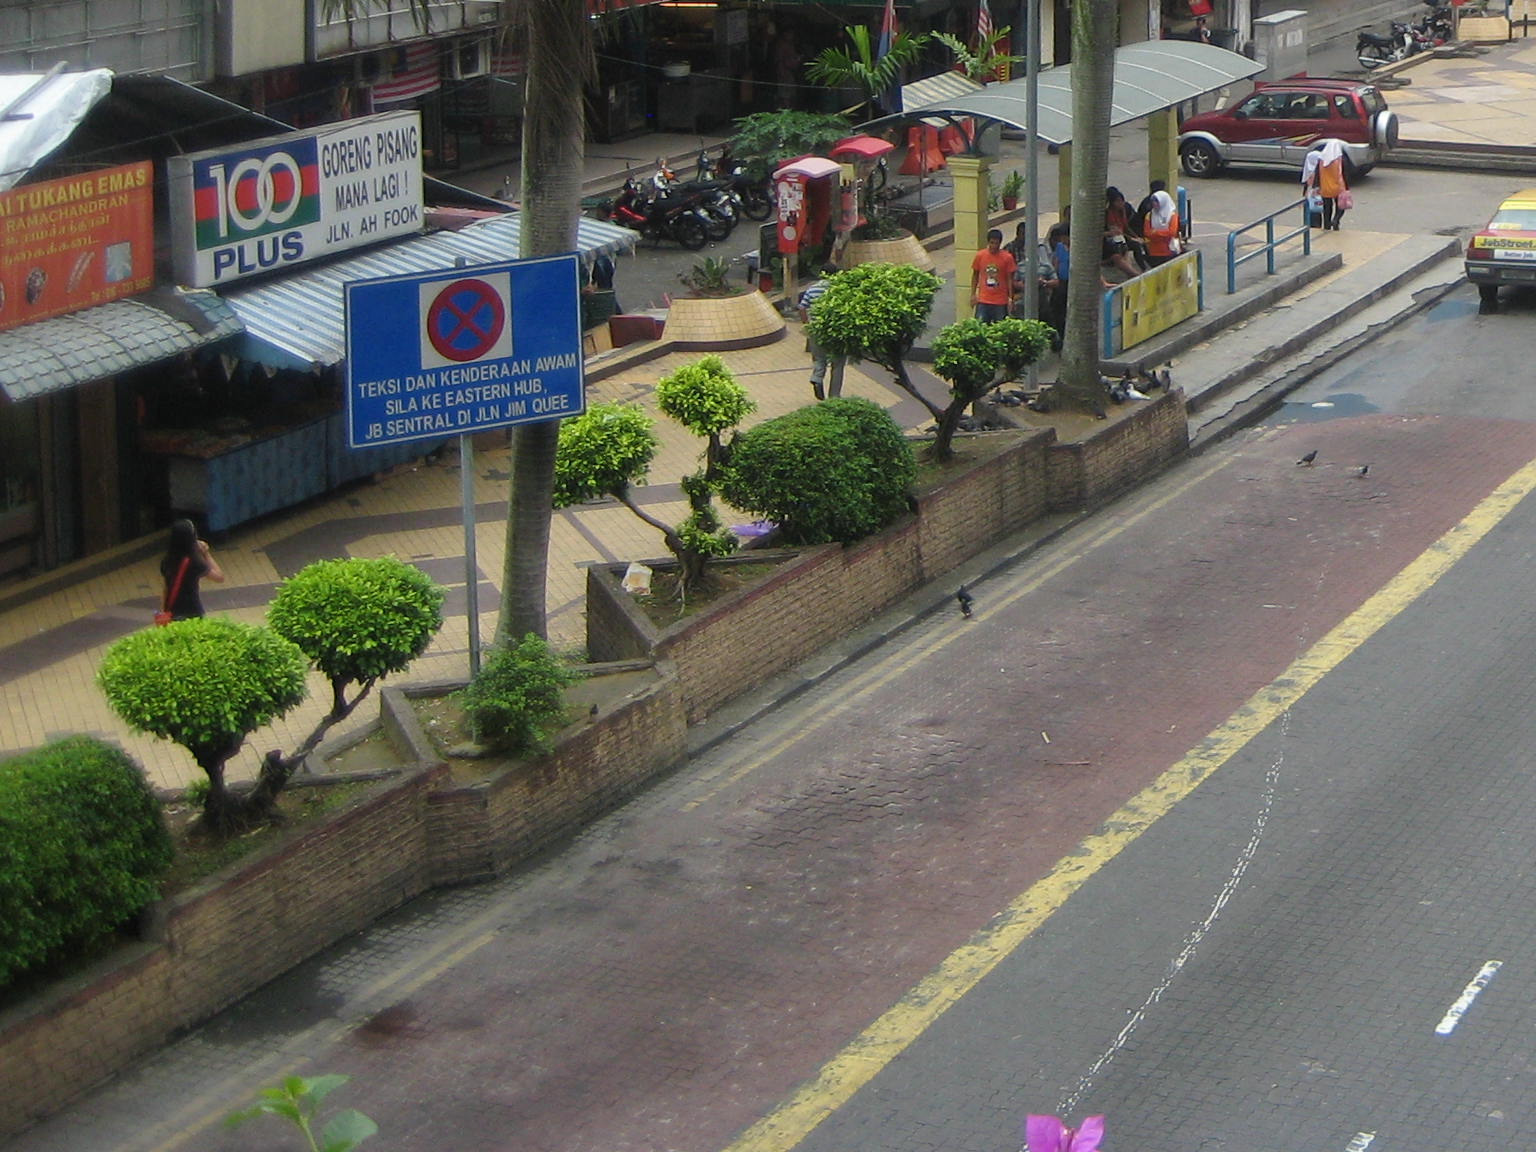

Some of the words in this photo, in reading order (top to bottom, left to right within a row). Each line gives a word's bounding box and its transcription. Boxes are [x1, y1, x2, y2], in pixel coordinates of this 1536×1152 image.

[322, 136, 371, 179] GORENG
[377, 126, 418, 167] PISANG
[16, 179, 93, 212] TUKANG
[97, 168, 146, 195] EMAS
[209, 152, 302, 238] 100
[335, 180, 369, 212] MANA
[374, 175, 399, 202] LAGI
[404, 171, 408, 195] !
[7, 194, 129, 233] RAMACHANDRAN
[326, 223, 354, 244] JLN.
[360, 216, 377, 235] AH
[384, 204, 418, 228] FOOK
[214, 231, 304, 280] PLUS
[1522, 251, 1533, 259] Job
[358, 378, 400, 398] TEKSI
[406, 373, 436, 392] DAN
[440, 360, 531, 386] KENDERAAN
[535, 353, 576, 372] AWAM
[386, 397, 418, 415] SILA
[422, 393, 441, 410] KE
[445, 382, 511, 407] EASTERN
[514, 378, 548, 396] HUB,
[366, 424, 382, 440] JB
[386, 411, 454, 436] SENTRAL
[458, 410, 471, 425] DI
[475, 406, 500, 422] JLN
[504, 401, 526, 418] JIM
[532, 394, 569, 413] QUEE
